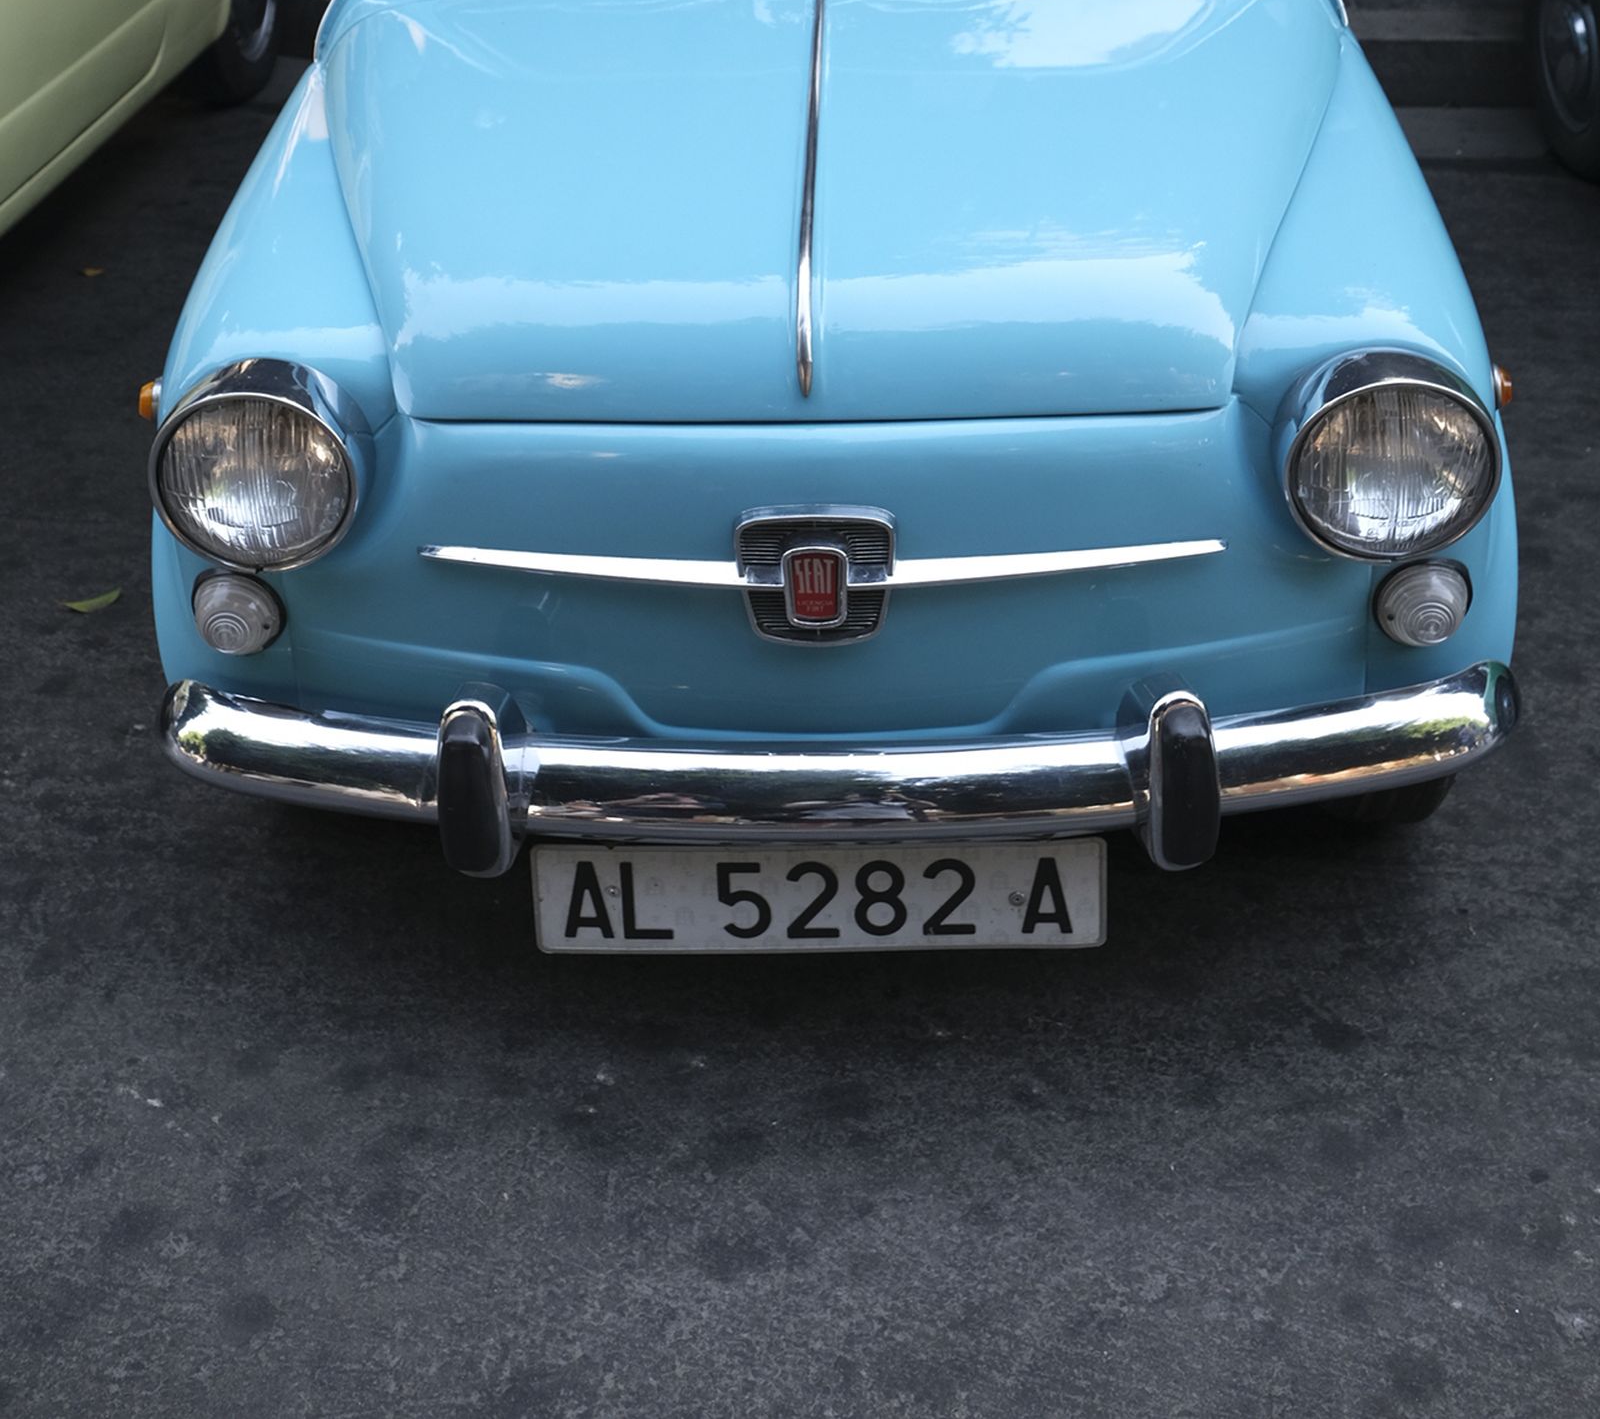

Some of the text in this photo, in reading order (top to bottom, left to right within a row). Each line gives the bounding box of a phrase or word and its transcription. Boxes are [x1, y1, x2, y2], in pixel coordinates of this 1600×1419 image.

[794, 557, 834, 595] SEAT
[564, 857, 1074, 940] AL 5282 A
